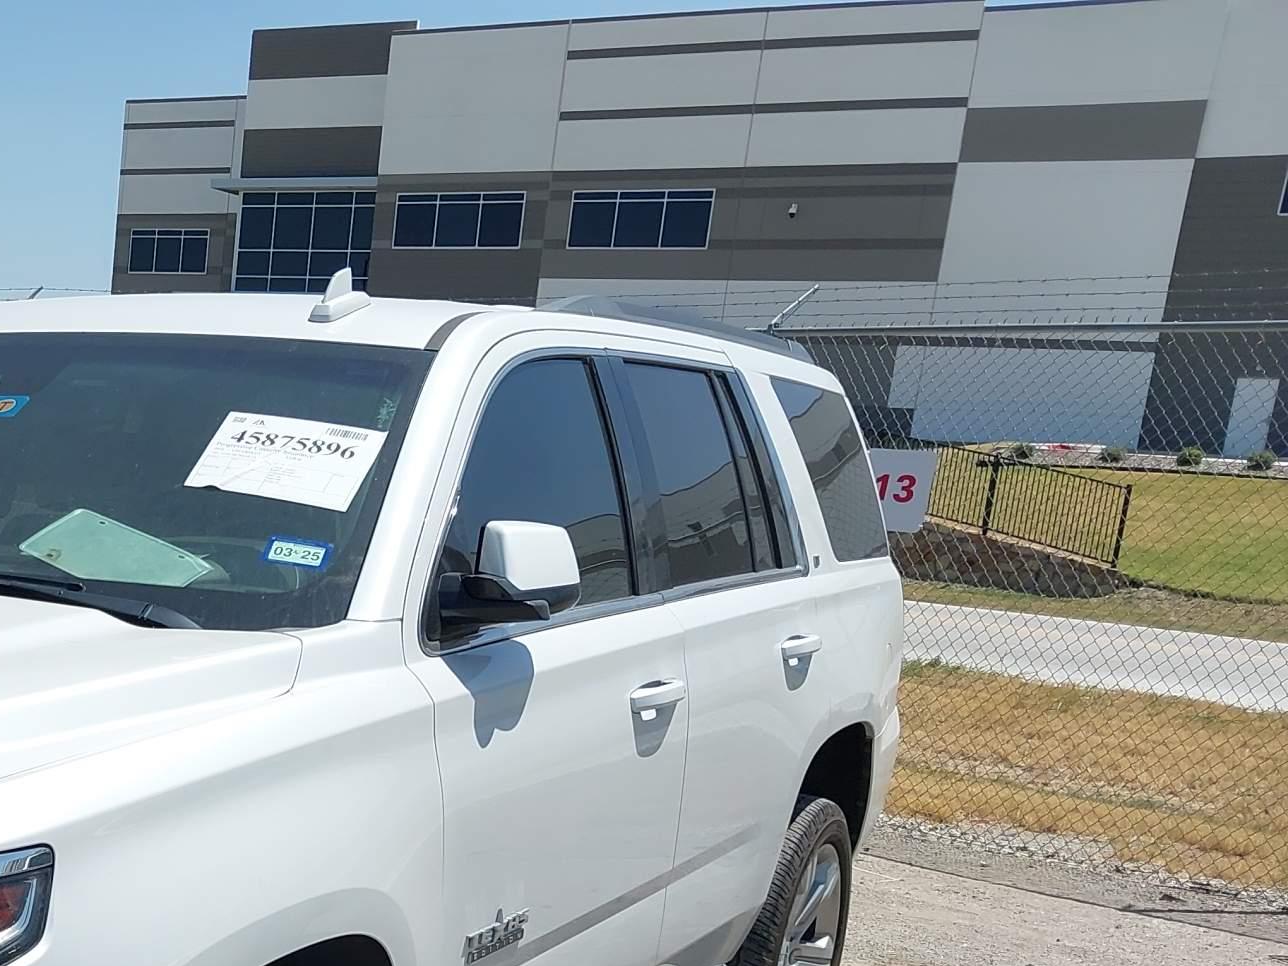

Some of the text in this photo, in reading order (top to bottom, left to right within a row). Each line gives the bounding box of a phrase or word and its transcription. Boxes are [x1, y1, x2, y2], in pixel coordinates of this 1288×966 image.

[230, 429, 360, 460] 45875896
[875, 474, 917, 504] 13
[273, 546, 321, 561] 03 25
